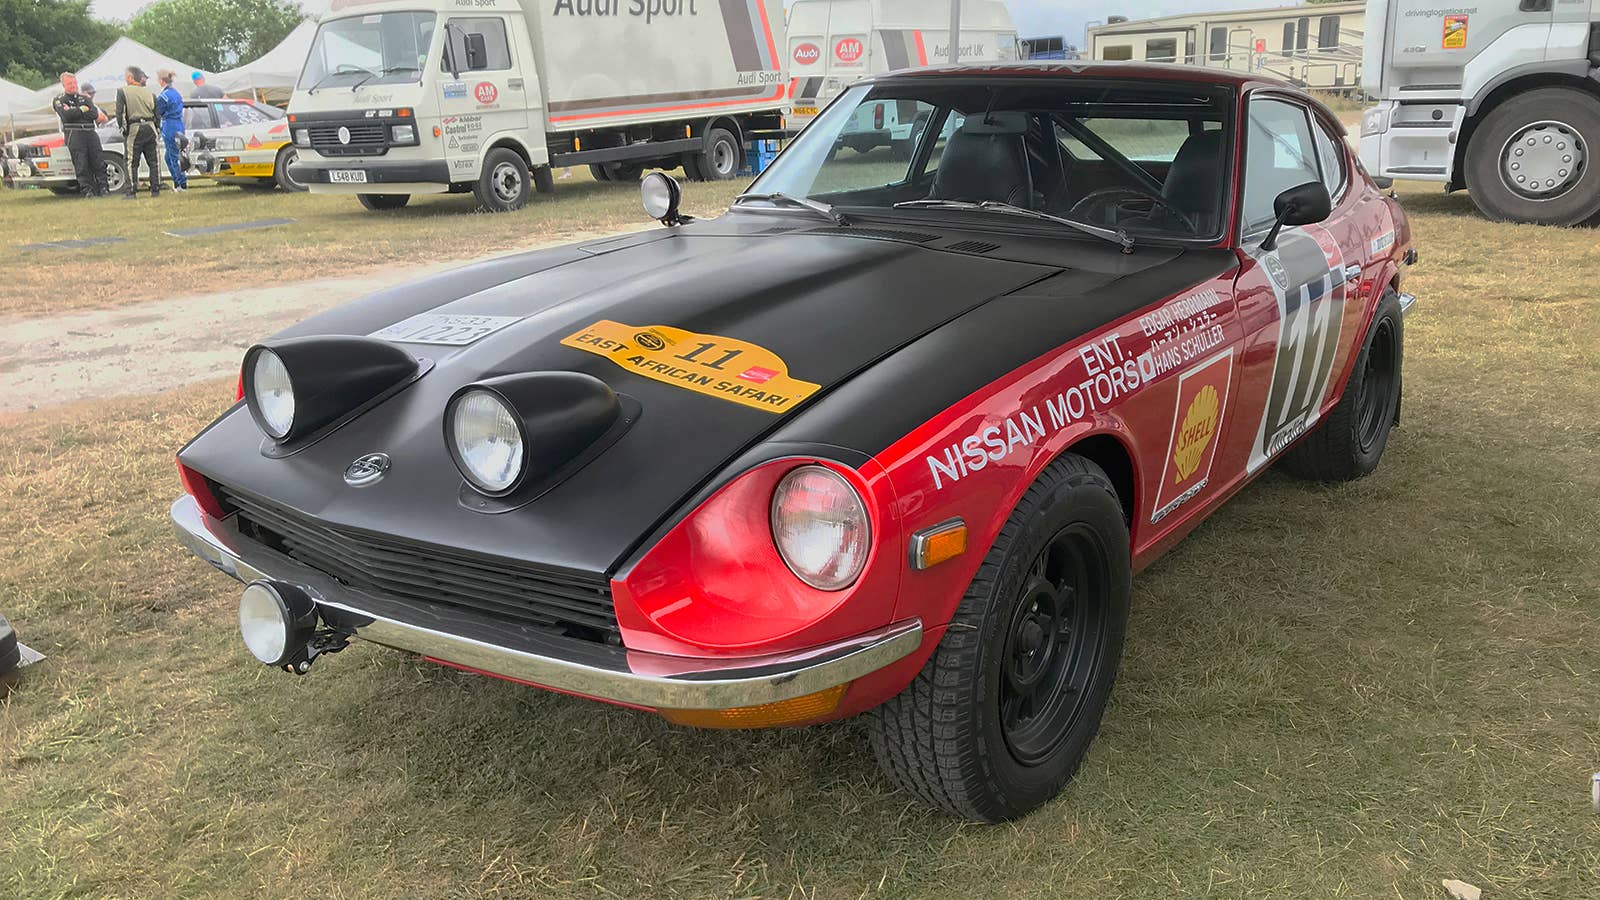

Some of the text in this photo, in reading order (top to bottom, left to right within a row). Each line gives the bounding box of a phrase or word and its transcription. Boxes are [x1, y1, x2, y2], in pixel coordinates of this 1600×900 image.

[629, 0, 698, 24] Sport
[796, 47, 818, 58] Audi
[840, 42, 860, 53] AM
[933, 43, 950, 57] Aud
[478, 86, 495, 96] AM
[737, 71, 782, 85] Audi Sport
[1138, 304, 1174, 337] EDGAR
[674, 340, 744, 371] 11
[1154, 346, 1182, 376] HANS
[575, 333, 630, 353] EAST
[626, 355, 714, 386] AFRICAN
[713, 380, 790, 406] SAFARI
[926, 359, 1141, 490] NISSAN MOTORS
[1181, 416, 1212, 452] SHELL
